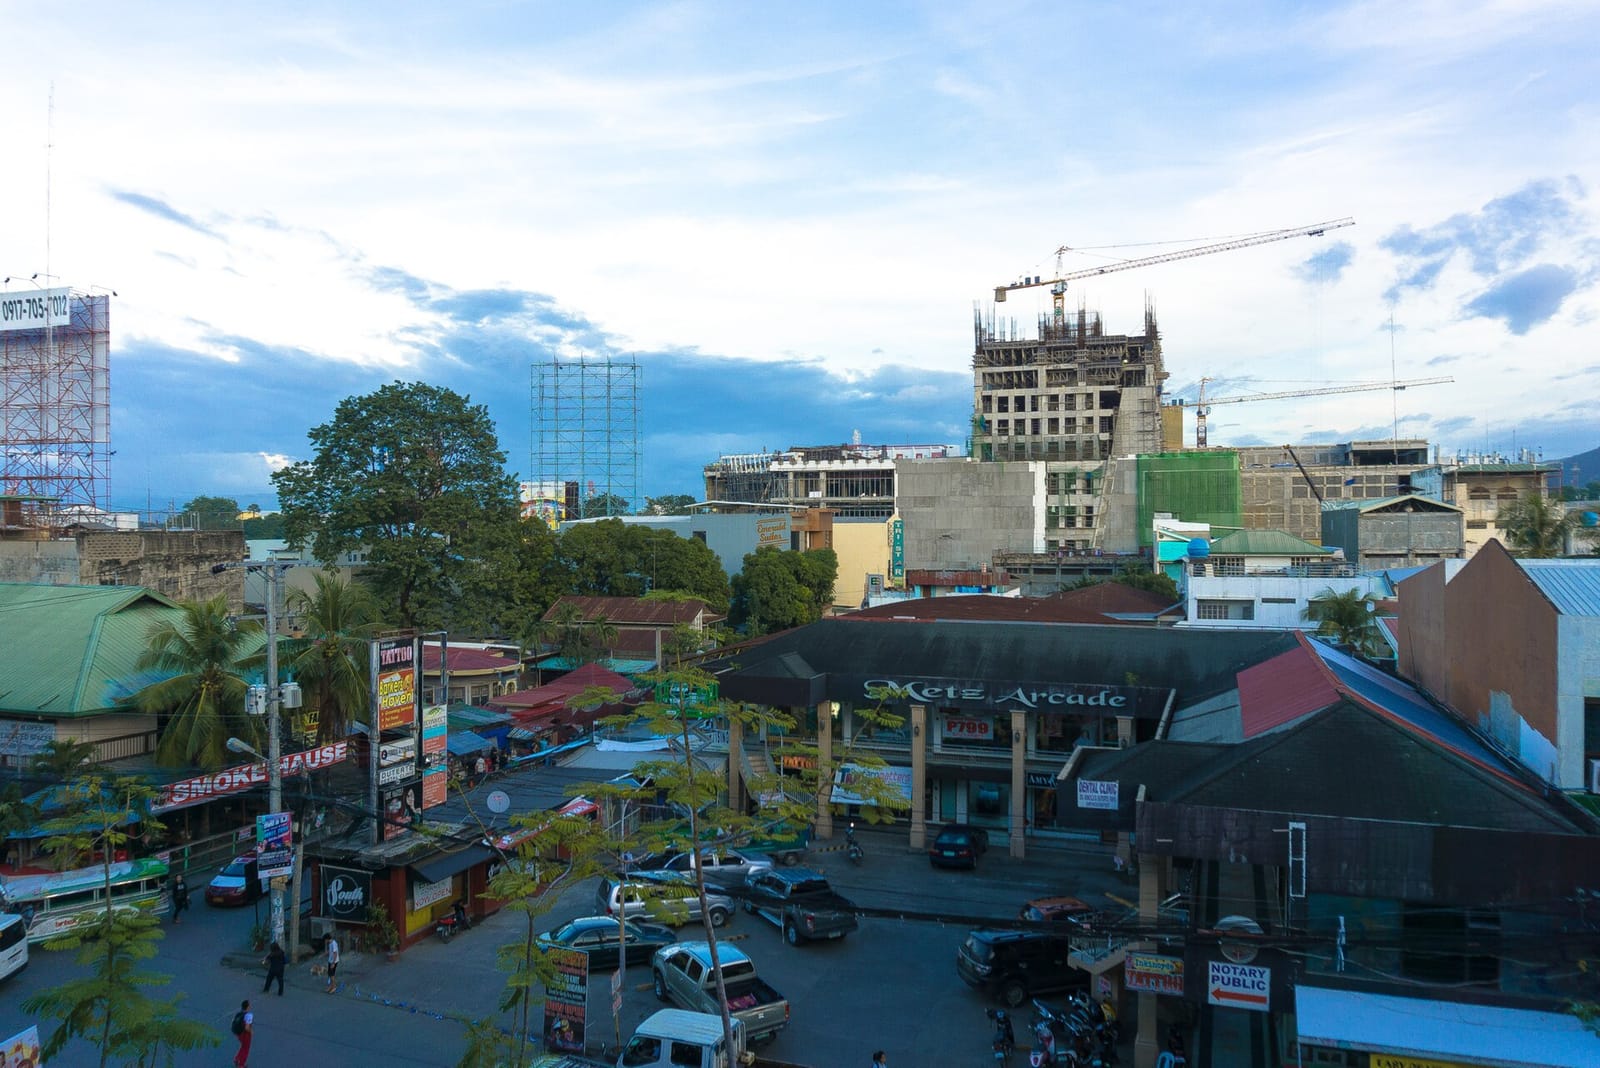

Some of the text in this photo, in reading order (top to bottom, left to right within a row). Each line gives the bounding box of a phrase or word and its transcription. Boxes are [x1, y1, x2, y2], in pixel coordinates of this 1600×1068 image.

[2, 295, 68, 321] 0917-705-7012
[380, 646, 413, 665] TATTOO
[998, 687, 1127, 708] Arcade
[381, 765, 414, 780] DUTERTE
[172, 762, 266, 803] SMOKE
[1079, 782, 1118, 795] DENTAL CLINIC
[327, 879, 364, 906] South
[432, 888, 452, 900] OPEN
[1211, 964, 1266, 979] NOTARY
[1211, 975, 1266, 991] PUBLIC
